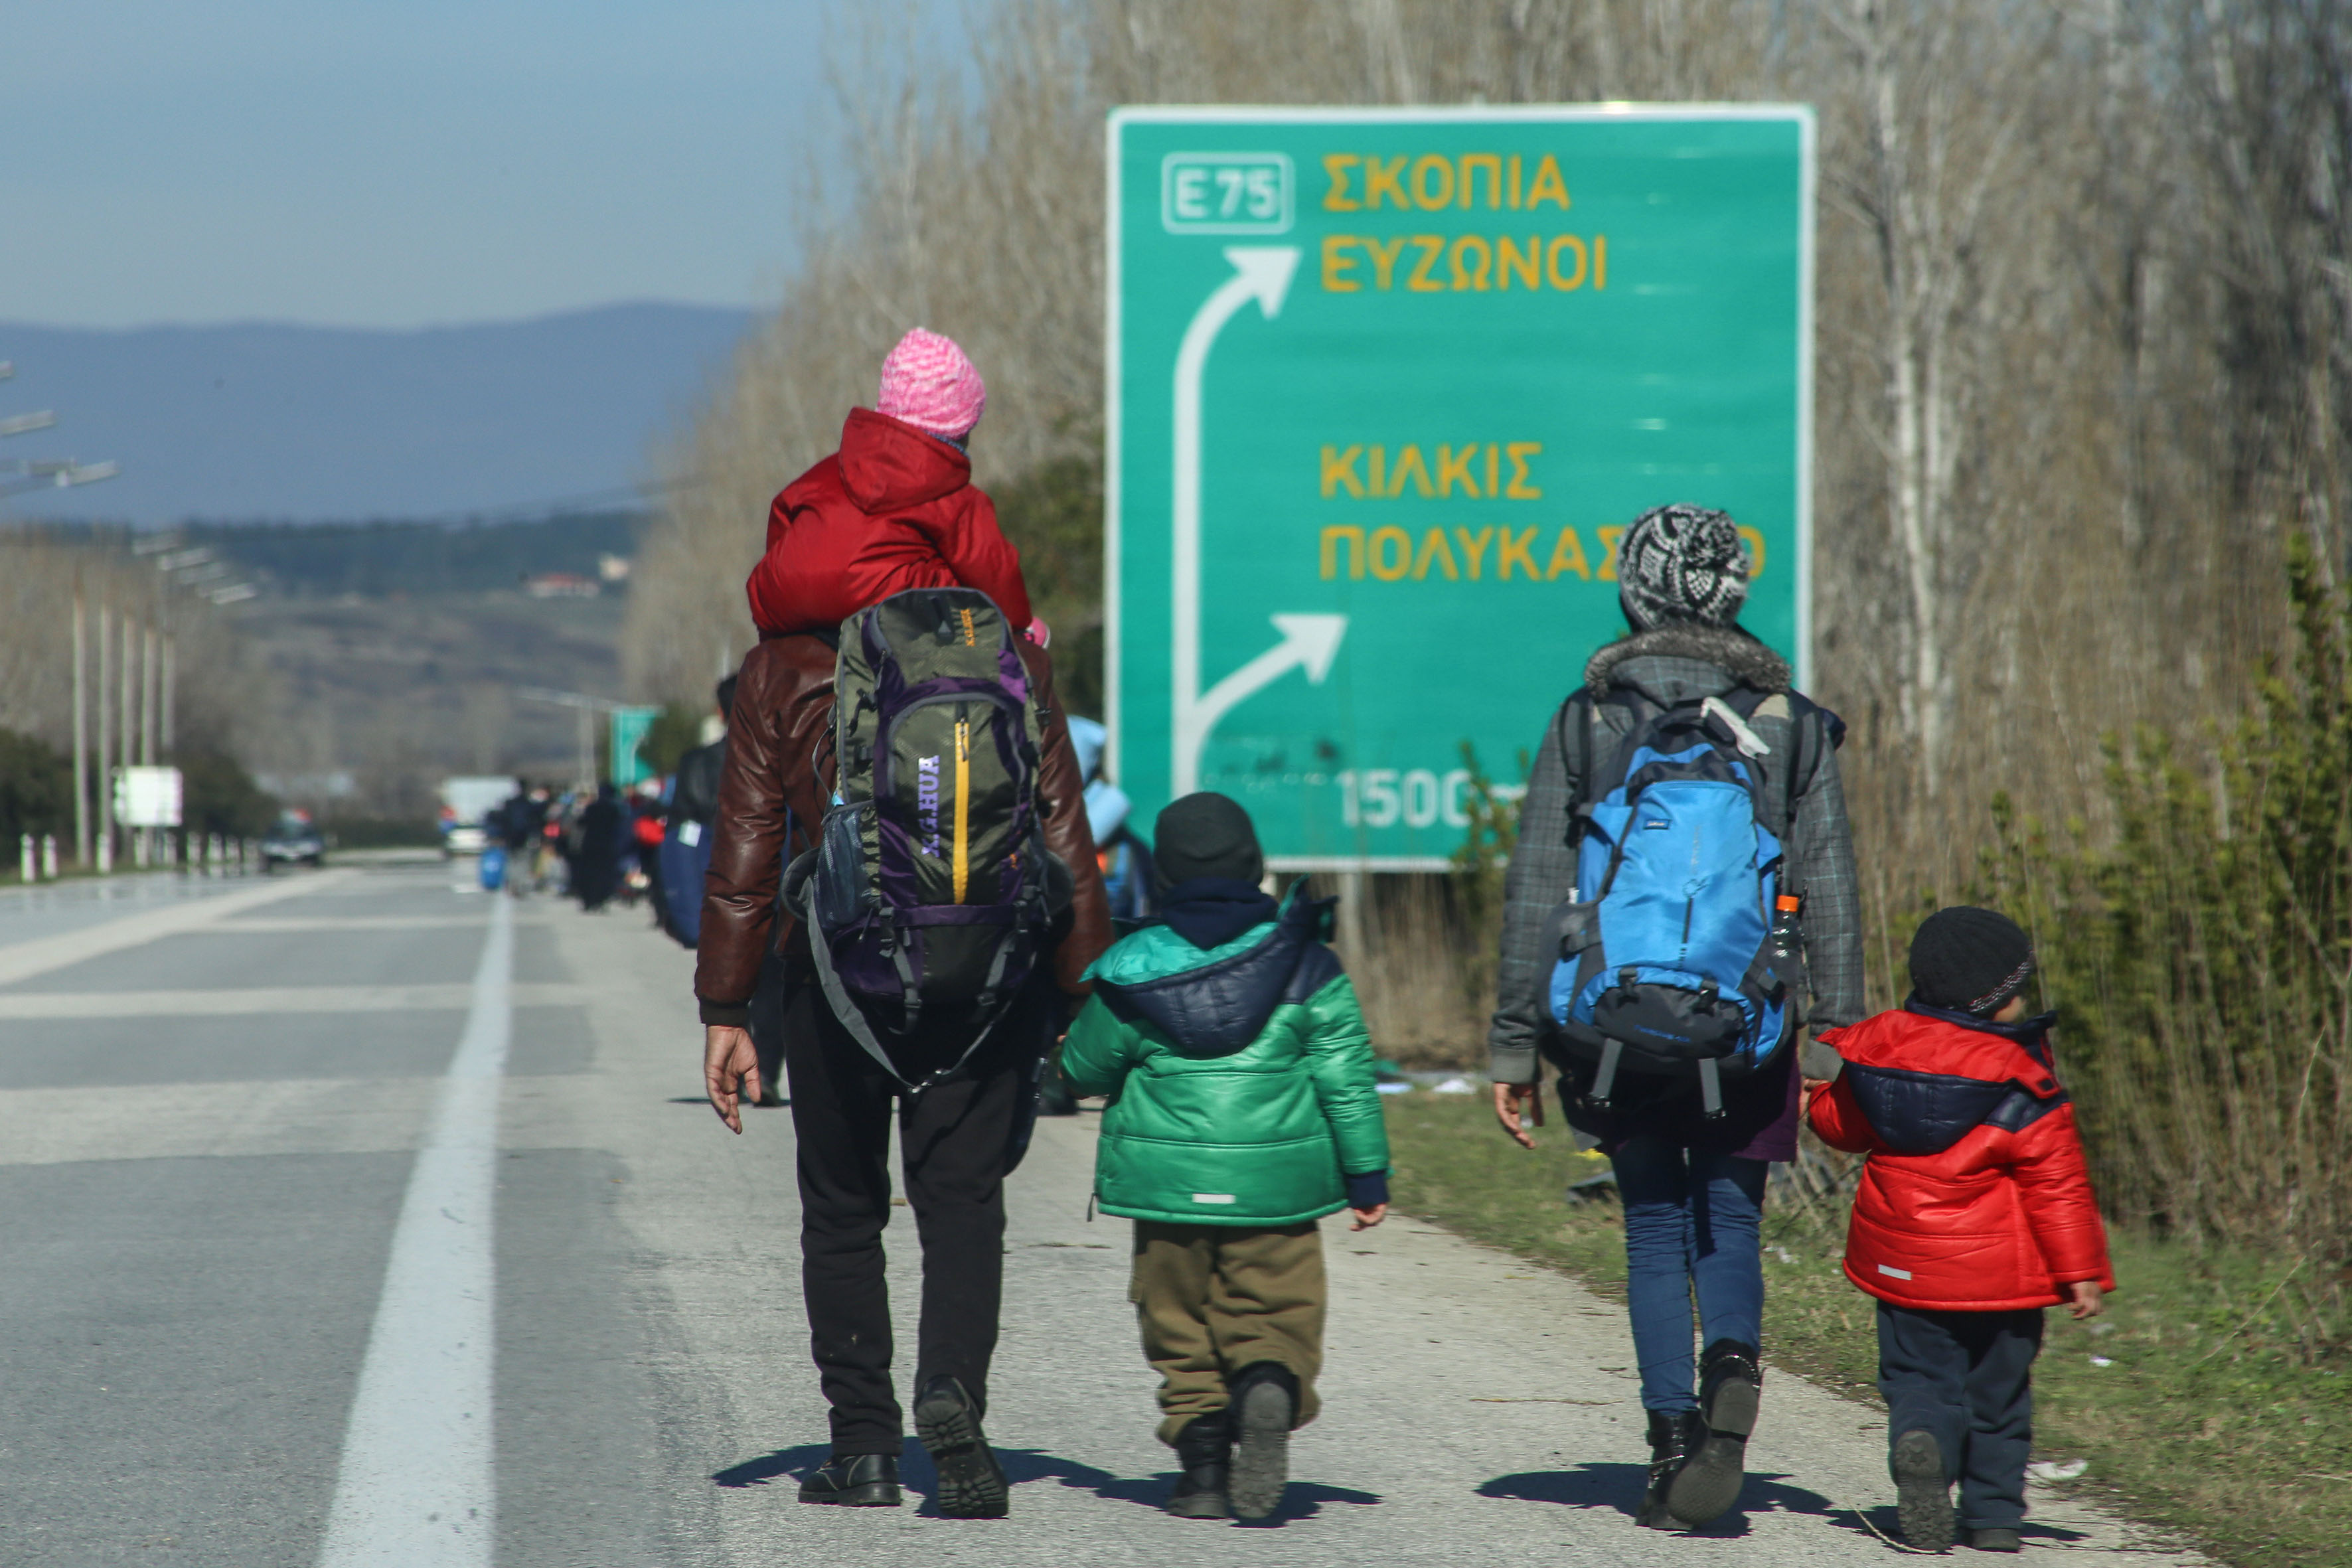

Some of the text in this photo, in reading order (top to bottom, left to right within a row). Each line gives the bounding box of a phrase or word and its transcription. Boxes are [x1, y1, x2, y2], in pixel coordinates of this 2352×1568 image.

[1322, 153, 1571, 212] ΣΚΟΠΙΑ
[1322, 234, 1607, 292] ΕΥΖΩΝΟΙ
[1320, 441, 1541, 500] ΚΙΛΚΙΣ
